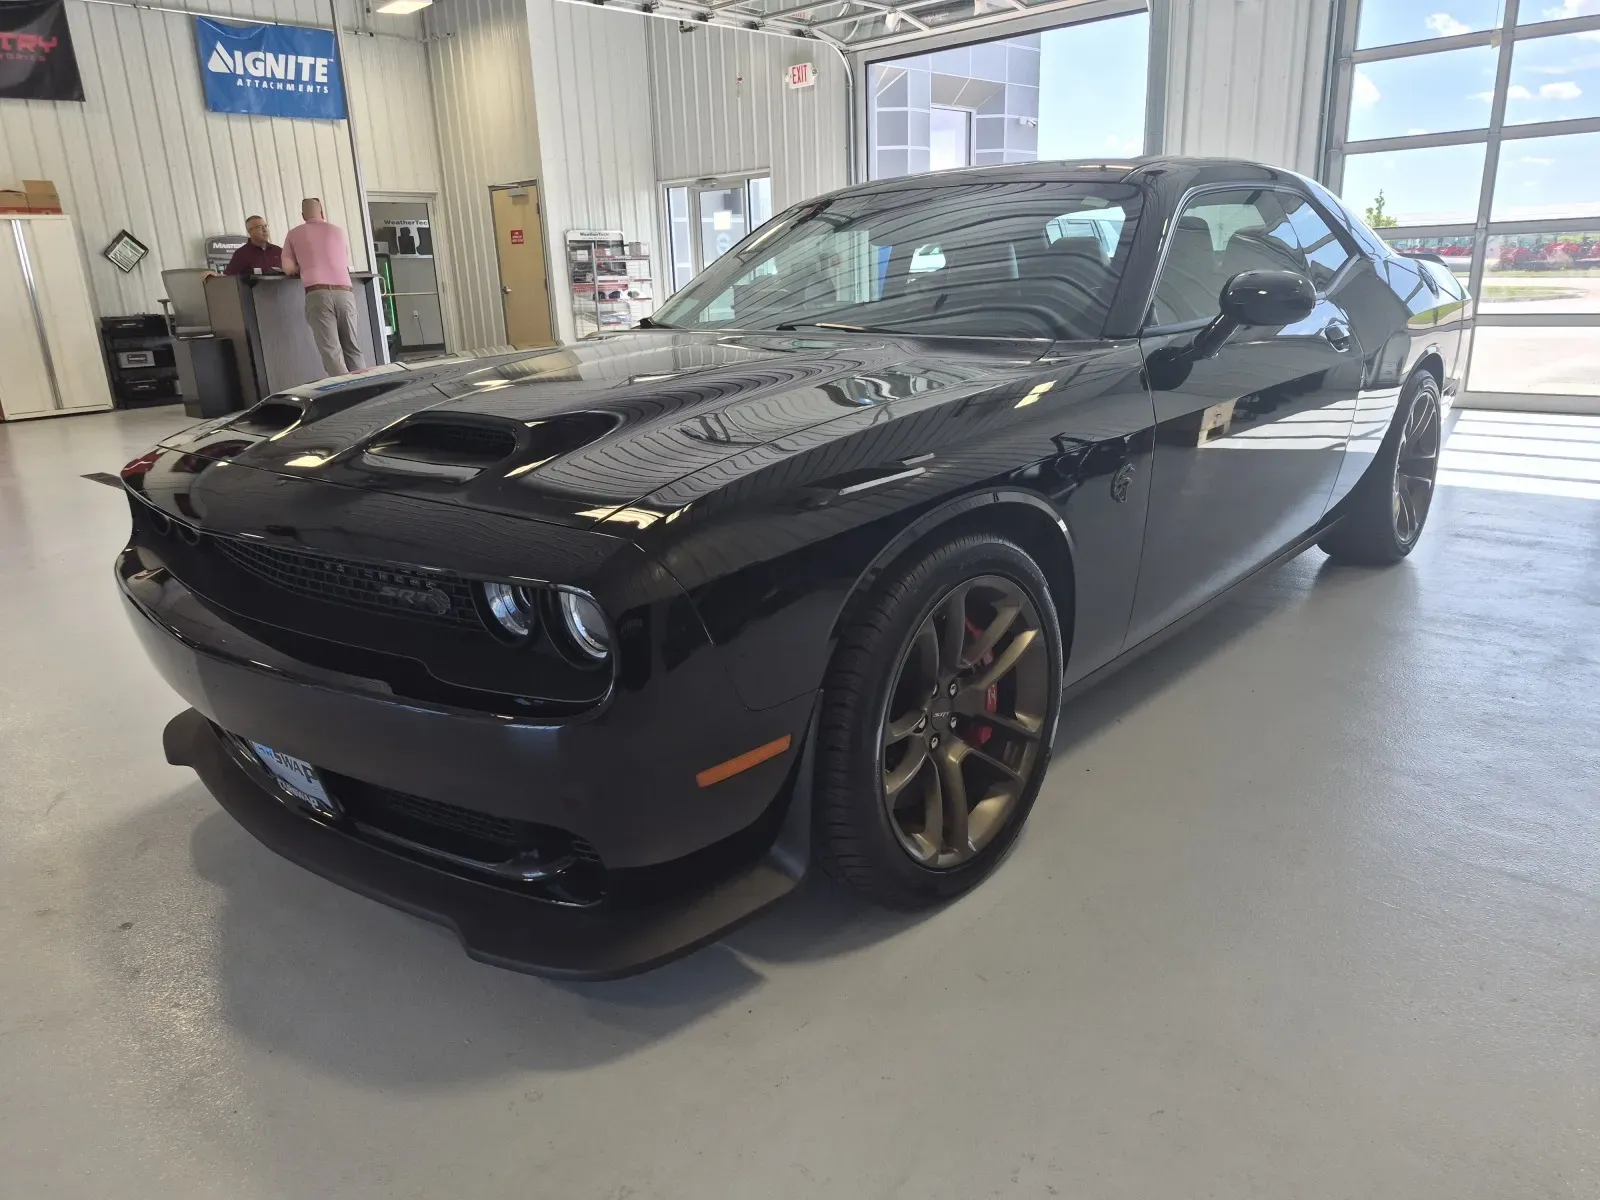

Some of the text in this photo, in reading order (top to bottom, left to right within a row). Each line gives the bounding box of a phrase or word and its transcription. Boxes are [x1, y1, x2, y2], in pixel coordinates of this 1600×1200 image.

[234, 50, 328, 83] IGNITE
[792, 64, 807, 84] EXIT
[237, 78, 329, 93] ATTACHMENTS
